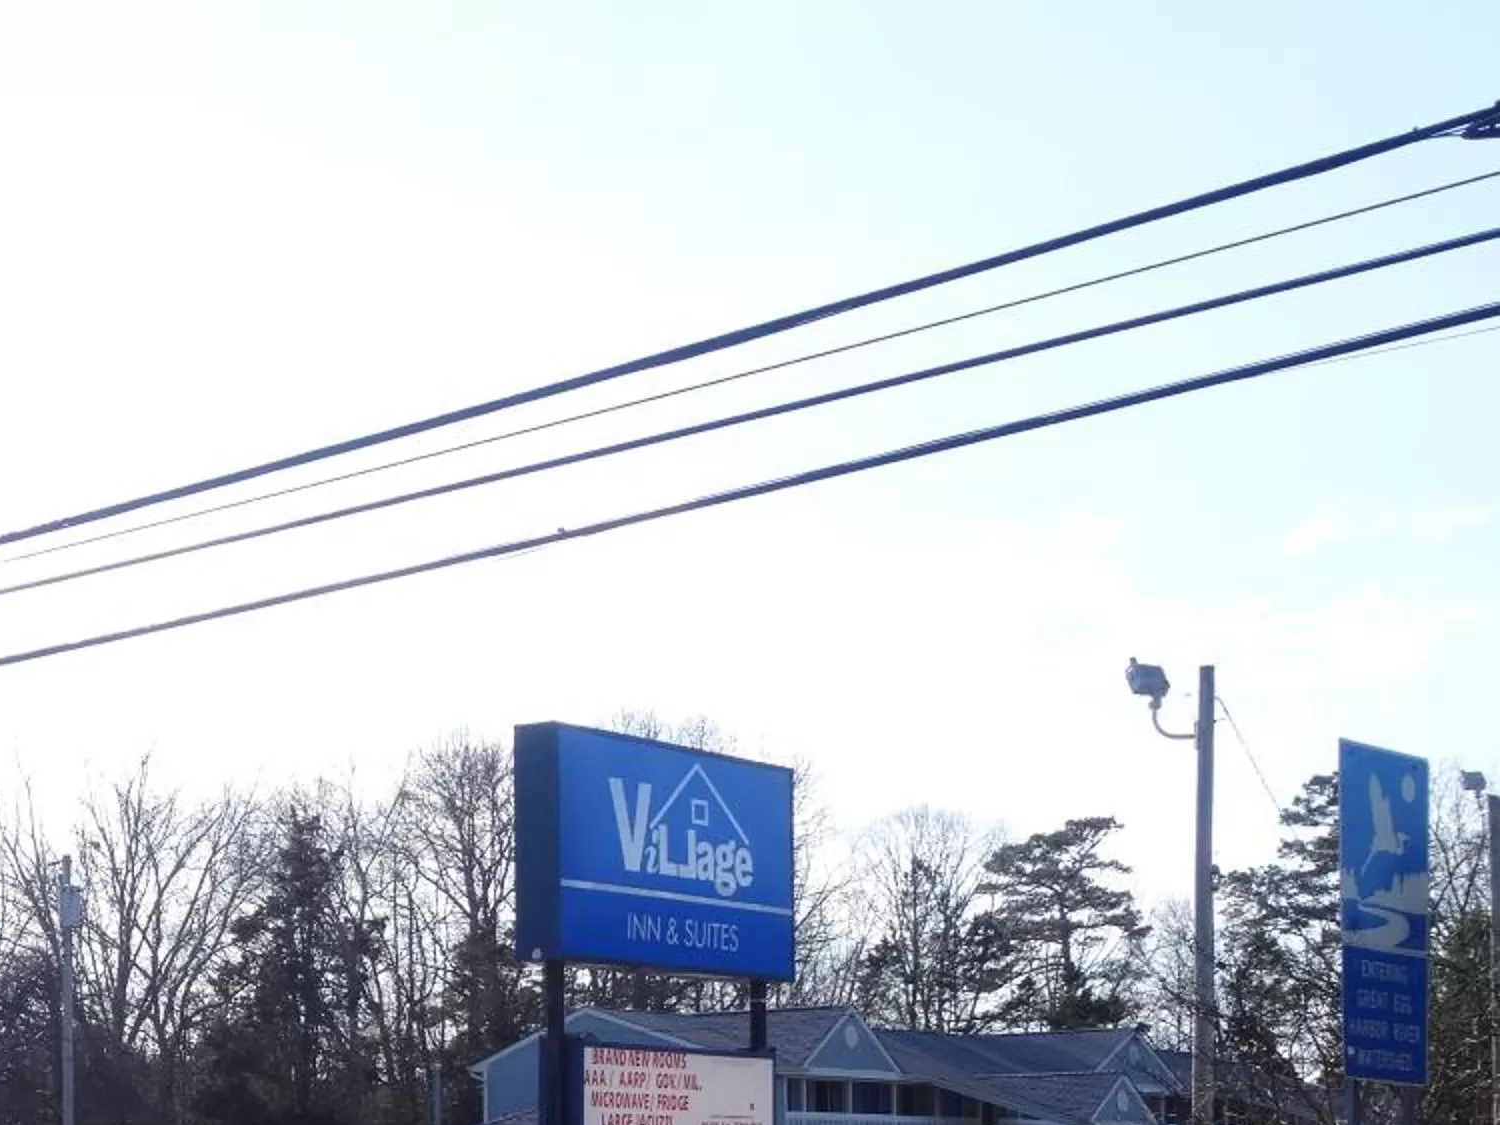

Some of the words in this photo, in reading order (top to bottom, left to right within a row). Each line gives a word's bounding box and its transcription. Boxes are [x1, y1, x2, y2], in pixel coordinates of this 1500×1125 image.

[627, 911, 661, 942] INN
[666, 917, 680, 945] &
[685, 919, 740, 953] SUITES
[591, 1048, 626, 1066] BRAND
[628, 1050, 650, 1067] NEW
[653, 1051, 687, 1069] ROOMS
[657, 1094, 689, 1111] FRIDGE
